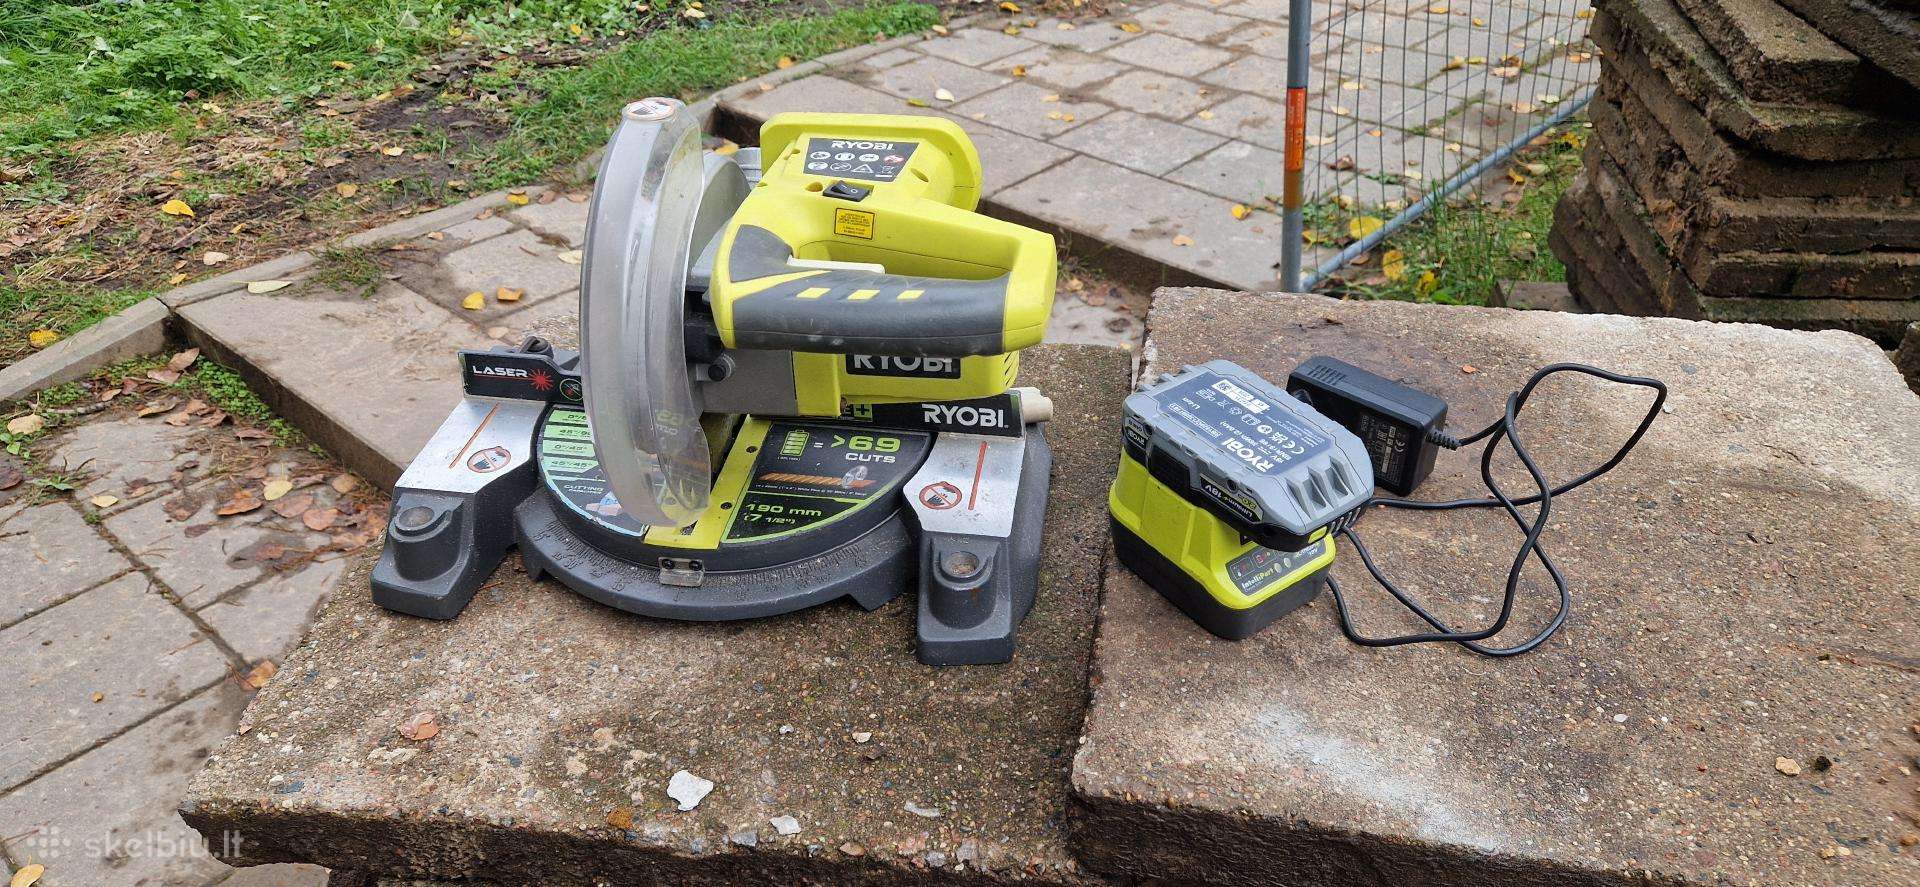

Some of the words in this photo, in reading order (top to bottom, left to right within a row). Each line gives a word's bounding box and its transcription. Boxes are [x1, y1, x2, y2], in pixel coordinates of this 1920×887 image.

[832, 140, 892, 151] RYOBI
[472, 365, 528, 378] LASER
[921, 403, 1004, 428] RYOBI
[845, 452, 897, 464] CUTS
[1221, 437, 1274, 473] RYOBI
[1204, 485, 1222, 498] 18V
[745, 503, 784, 513] 190
[789, 508, 822, 517] mm
